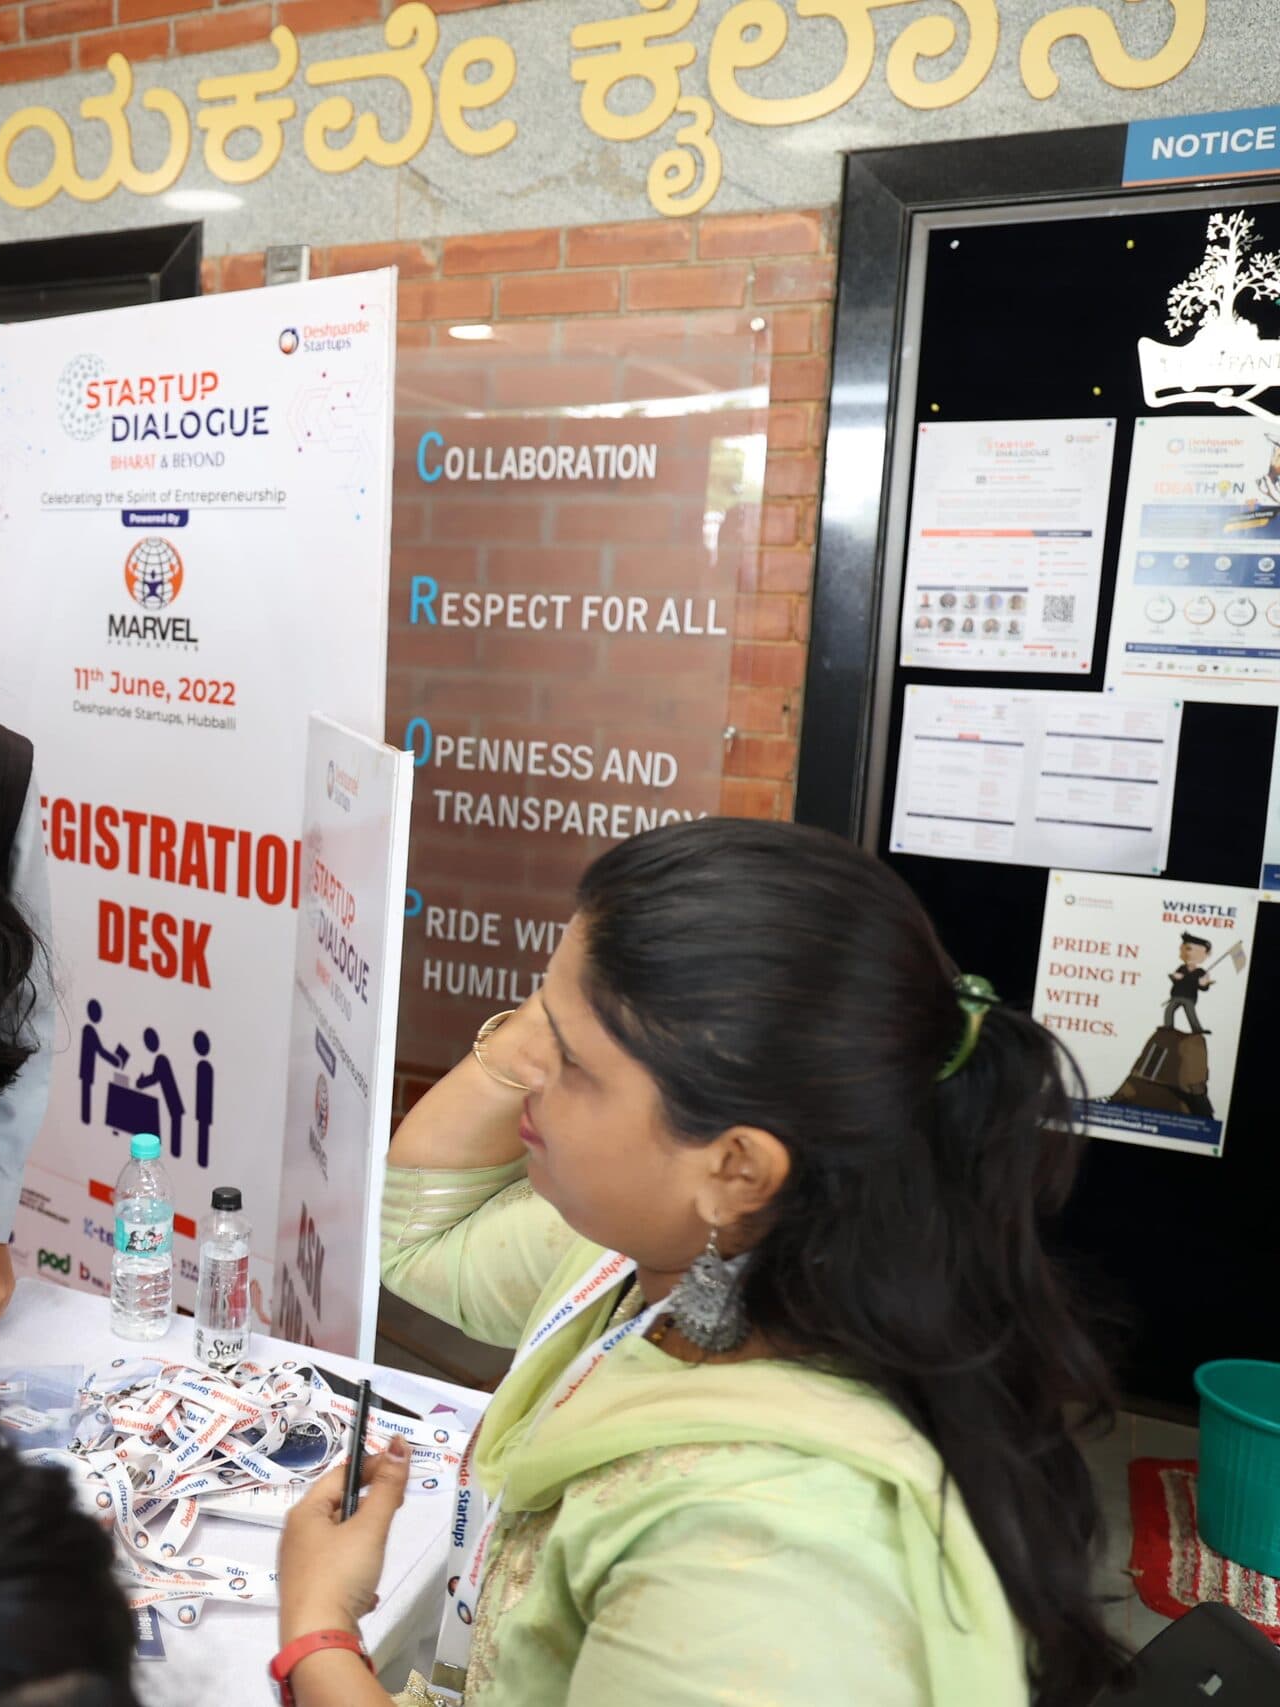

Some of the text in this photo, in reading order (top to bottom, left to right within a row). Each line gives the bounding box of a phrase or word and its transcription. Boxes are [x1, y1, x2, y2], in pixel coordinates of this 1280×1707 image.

[1151, 126, 1276, 161] NOTICE
[304, 320, 369, 339] Deshpande
[304, 336, 351, 352] Startups
[86, 371, 218, 409] STARTUP
[111, 406, 269, 442] DIALOGUE
[110, 451, 225, 471] BHARAT & BEYOND
[41, 488, 287, 506] Celebrating the Spirit of Entrepreneurship
[409, 575, 727, 635] RESPECT FOR ALL
[108, 614, 198, 643] MARVEL
[73, 667, 236, 707] 11th June, 2022
[73, 699, 236, 731] Deshpande Startups, Hubballi
[405, 717, 678, 788] OPENNESS AND
[1162, 900, 1237, 918] WHISTLE
[1162, 912, 1236, 929] BLOWER
[98, 899, 212, 990] DESK
[514, 918, 568, 953] WI
[1052, 935, 1139, 959] PRIDE IN
[317, 910, 370, 1004] DIALOGUE
[423, 959, 549, 1003] HUMILI
[1048, 962, 1141, 986] DOING IT
[1046, 988, 1100, 1008] WITH
[1043, 1014, 1118, 1037] ETHICS.
[573, 1254, 627, 1303] eshpande
[111, 1415, 155, 1432] eshpande
[376, 1417, 414, 1436] Startups
[237, 1451, 272, 1480] Startups
[115, 1479, 129, 1523] Startups
[170, 1478, 210, 1498] Startups
[451, 1490, 471, 1549] Startups
